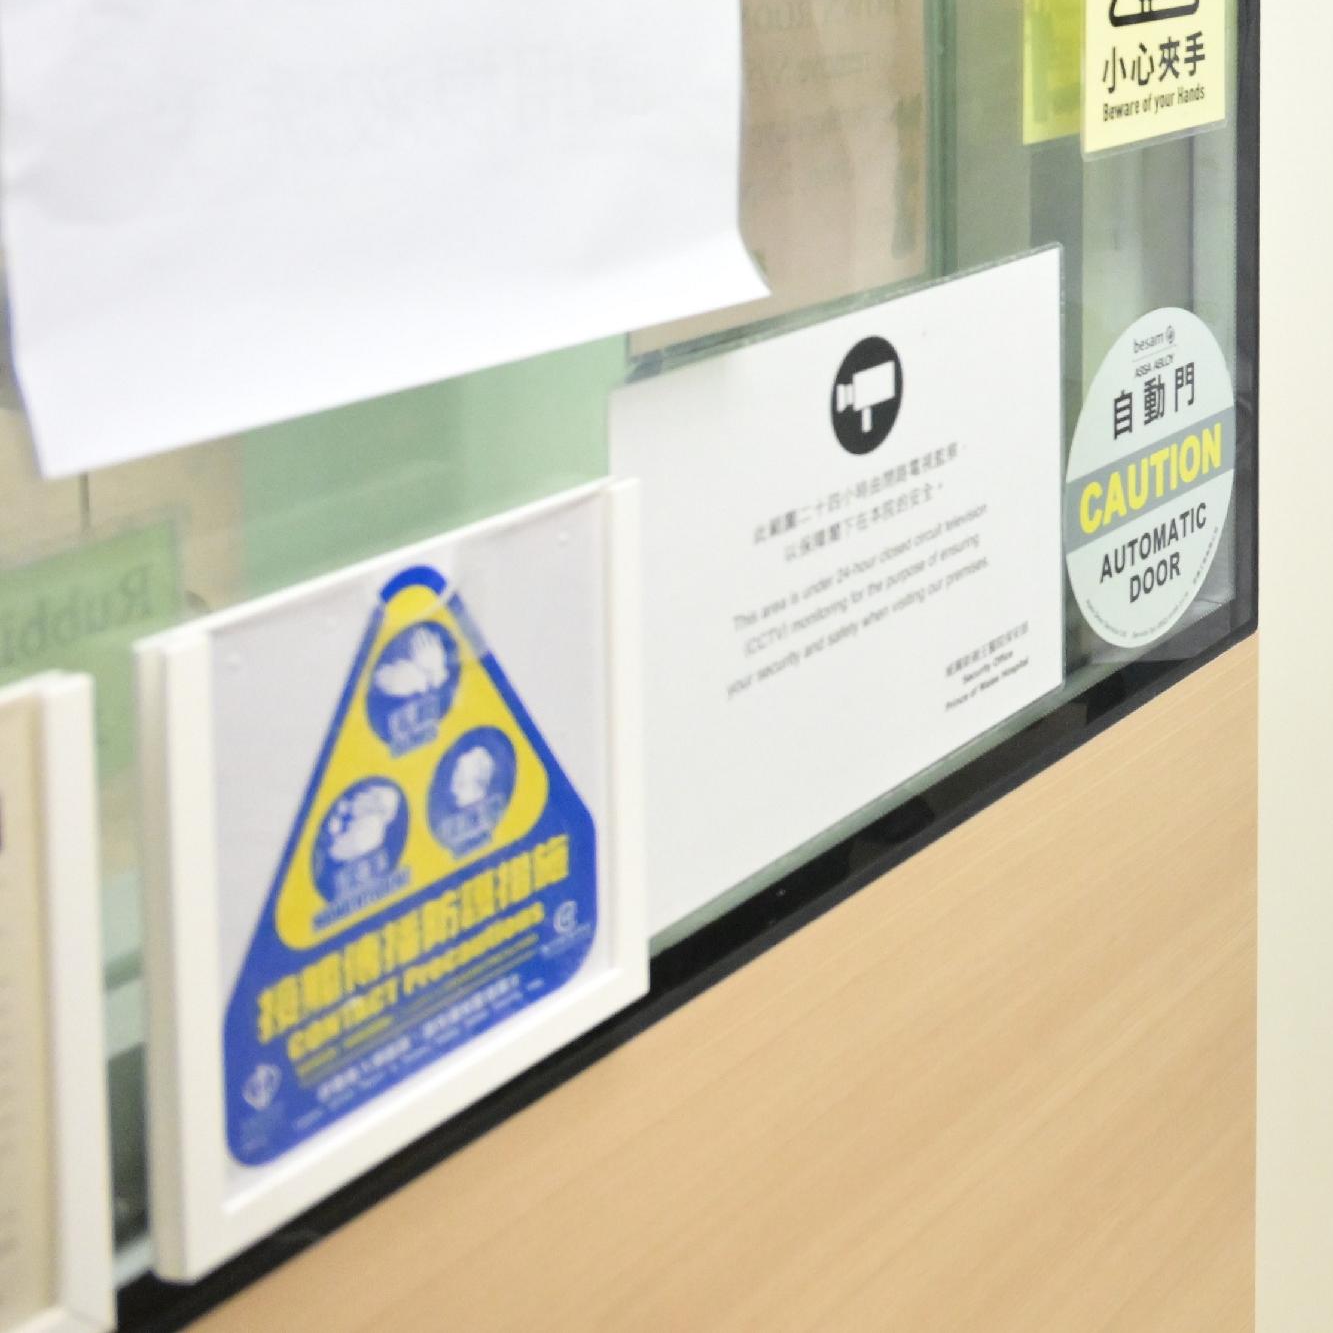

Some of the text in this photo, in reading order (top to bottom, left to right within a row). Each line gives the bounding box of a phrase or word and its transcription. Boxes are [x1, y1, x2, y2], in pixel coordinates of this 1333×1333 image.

[1103, 31, 1205, 93] 小心夾手
[1103, 83, 1205, 122] Beware of your Hands
[1114, 362, 1195, 440] 自動門
[1079, 423, 1222, 533] CAUTION
[733, 612, 757, 630] This
[761, 599, 786, 617] area
[802, 577, 834, 599] under
[879, 538, 912, 563] closed
[914, 523, 942, 546] circuit
[945, 503, 988, 530] television
[1100, 502, 1206, 584] AUTOMATIC
[1130, 552, 1180, 603] DOOR
[744, 623, 787, 657] (CCTV)
[791, 597, 848, 632] monitoring
[885, 560, 926, 589] purpose
[940, 533, 981, 561] ensuring
[727, 675, 752, 699] your
[757, 651, 800, 681] security
[804, 637, 824, 658] and
[827, 622, 859, 647] safety
[862, 606, 889, 627] when
[892, 588, 925, 613] visiting
